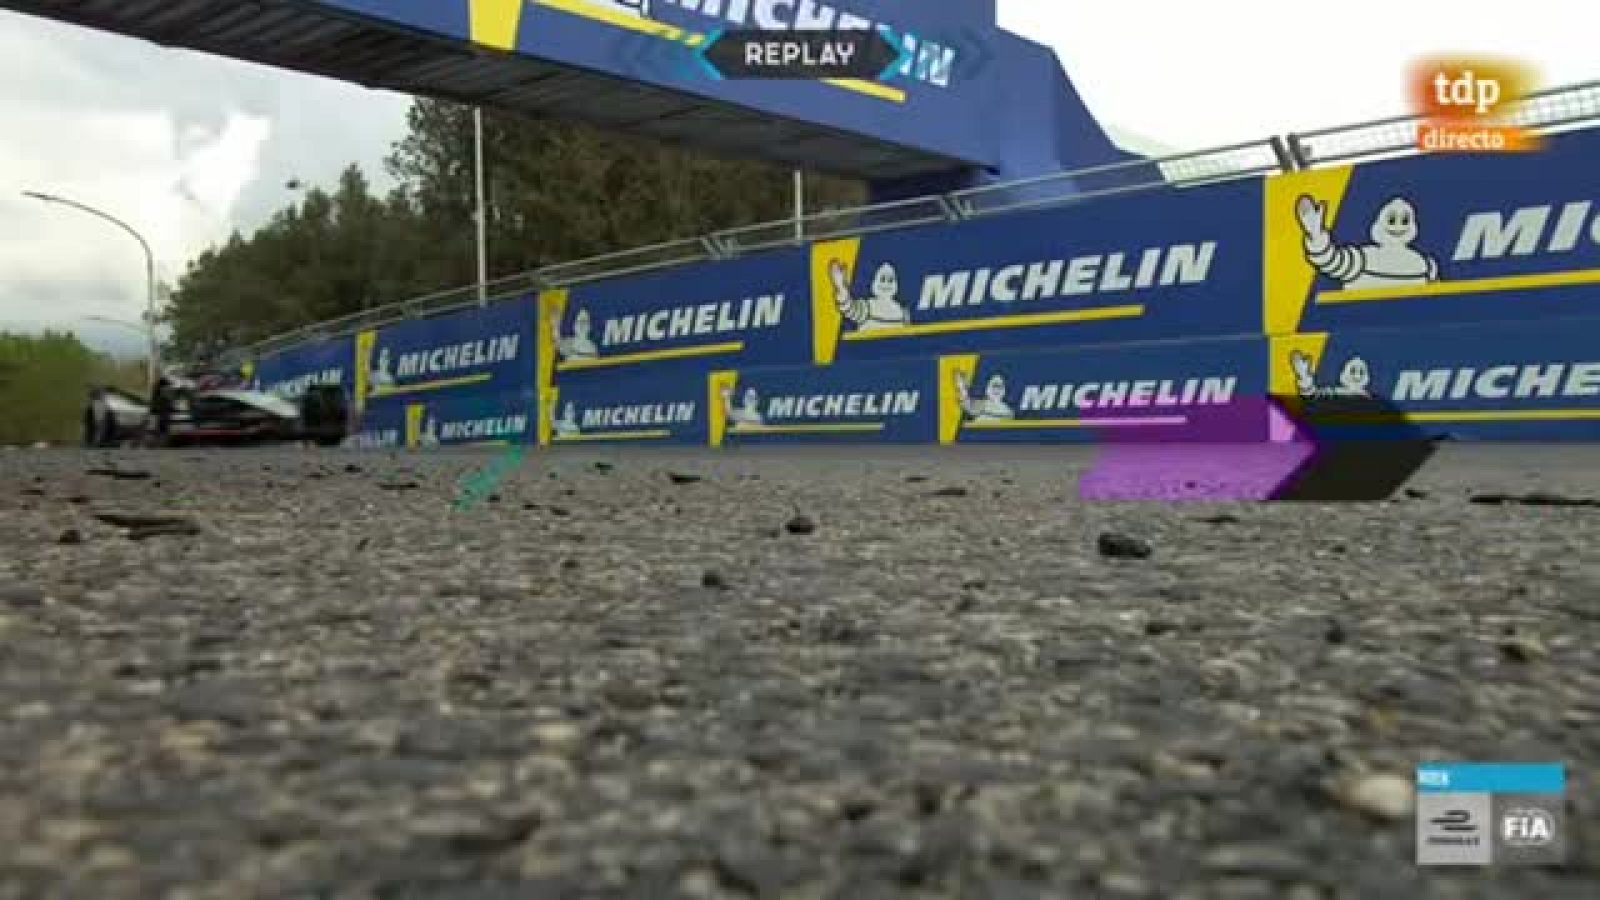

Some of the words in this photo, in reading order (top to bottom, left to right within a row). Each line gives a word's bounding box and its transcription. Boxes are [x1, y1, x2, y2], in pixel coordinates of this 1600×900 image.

[1452, 201, 1600, 261] MI
[917, 241, 1217, 310] MICHELIN
[602, 295, 784, 345] MICHELIN
[397, 334, 520, 376] MICHELIN
[1019, 376, 1237, 409] MICHELIN
[1392, 362, 1600, 401] MICHE
[581, 402, 695, 426] MICHELIN
[767, 390, 919, 418] MICHELIN
[441, 415, 528, 439] MICHELIN
